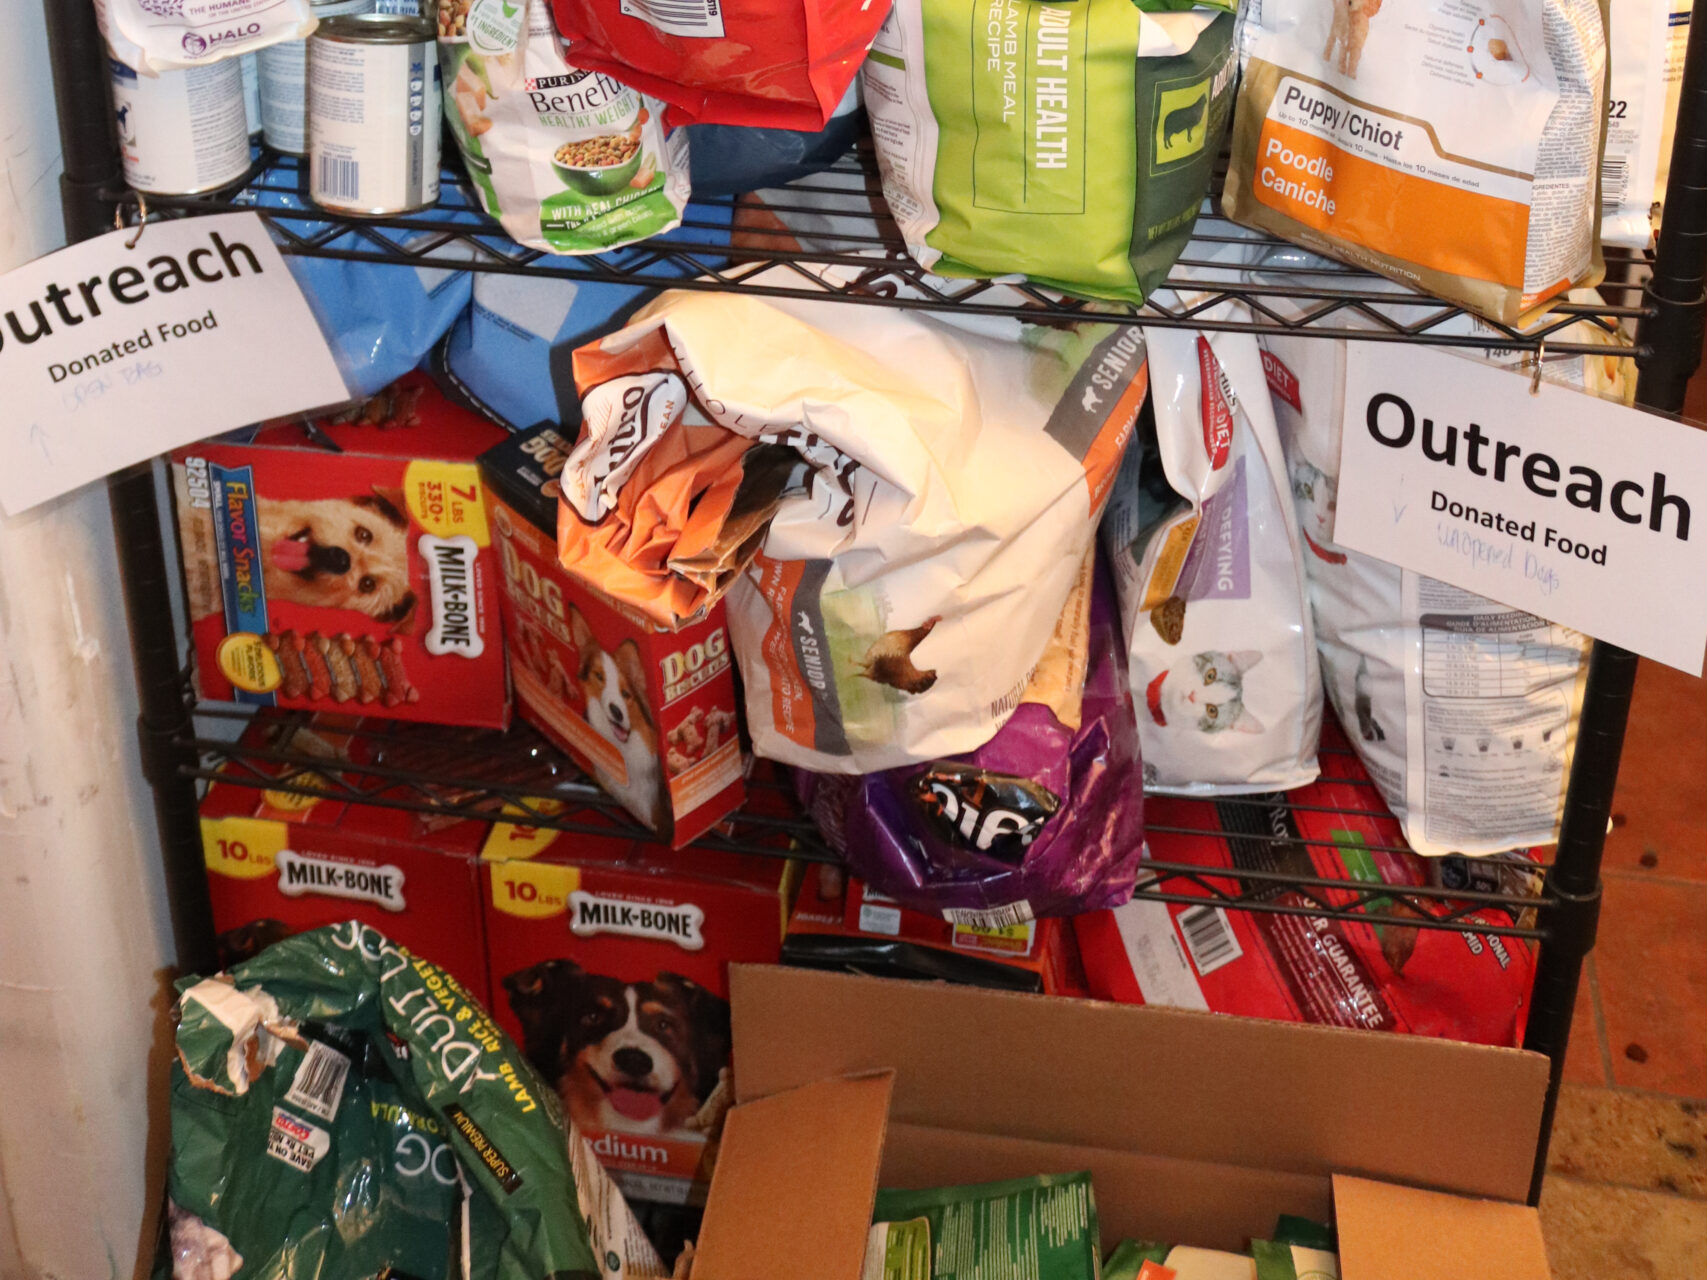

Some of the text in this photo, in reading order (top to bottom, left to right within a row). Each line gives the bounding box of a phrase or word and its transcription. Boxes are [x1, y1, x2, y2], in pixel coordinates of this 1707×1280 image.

[190, 5, 206, 15] THE
[208, 22, 261, 45] HALO
[1003, 0, 1021, 123] LAMB MEAL
[1036, 5, 1072, 169] ADULT HEALTH
[528, 71, 626, 114] Benefu
[538, 92, 636, 129] HEALTHY WEIGHT
[1265, 138, 1334, 183] Poodle
[551, 205, 582, 221] WITH
[585, 199, 612, 217] REAL
[1261, 167, 1336, 216] Caniche
[0, 231, 264, 356] utreach
[48, 310, 219, 384] Donated Food
[1093, 326, 1145, 391] SENIOR
[1263, 354, 1290, 388] DIET
[1215, 412, 1231, 448] DIET
[185, 456, 211, 510] 92504
[1366, 392, 1690, 542] Outreach
[427, 481, 442, 524] 330+
[451, 484, 476, 524] 7 LBS
[1431, 490, 1607, 566] Donated Food
[226, 480, 258, 613] Flavor Snacks
[1216, 507, 1234, 593] DEFYING
[433, 544, 471, 648] MILK-BONE
[659, 627, 725, 685] DOG
[663, 652, 730, 705] BISCUITS
[799, 635, 827, 692] SENIOR
[217, 838, 271, 865] 10 LBS
[286, 862, 394, 899] MILK-BONE
[503, 880, 564, 907] 10 LBS
[579, 901, 693, 937] MILK-BONE
[411, 958, 501, 1054] RICE & VEGET
[1322, 934, 1385, 1030] GUARANTEE
[394, 1132, 459, 1185] OG
[453, 1111, 509, 1178] SUPER PREMIUM
